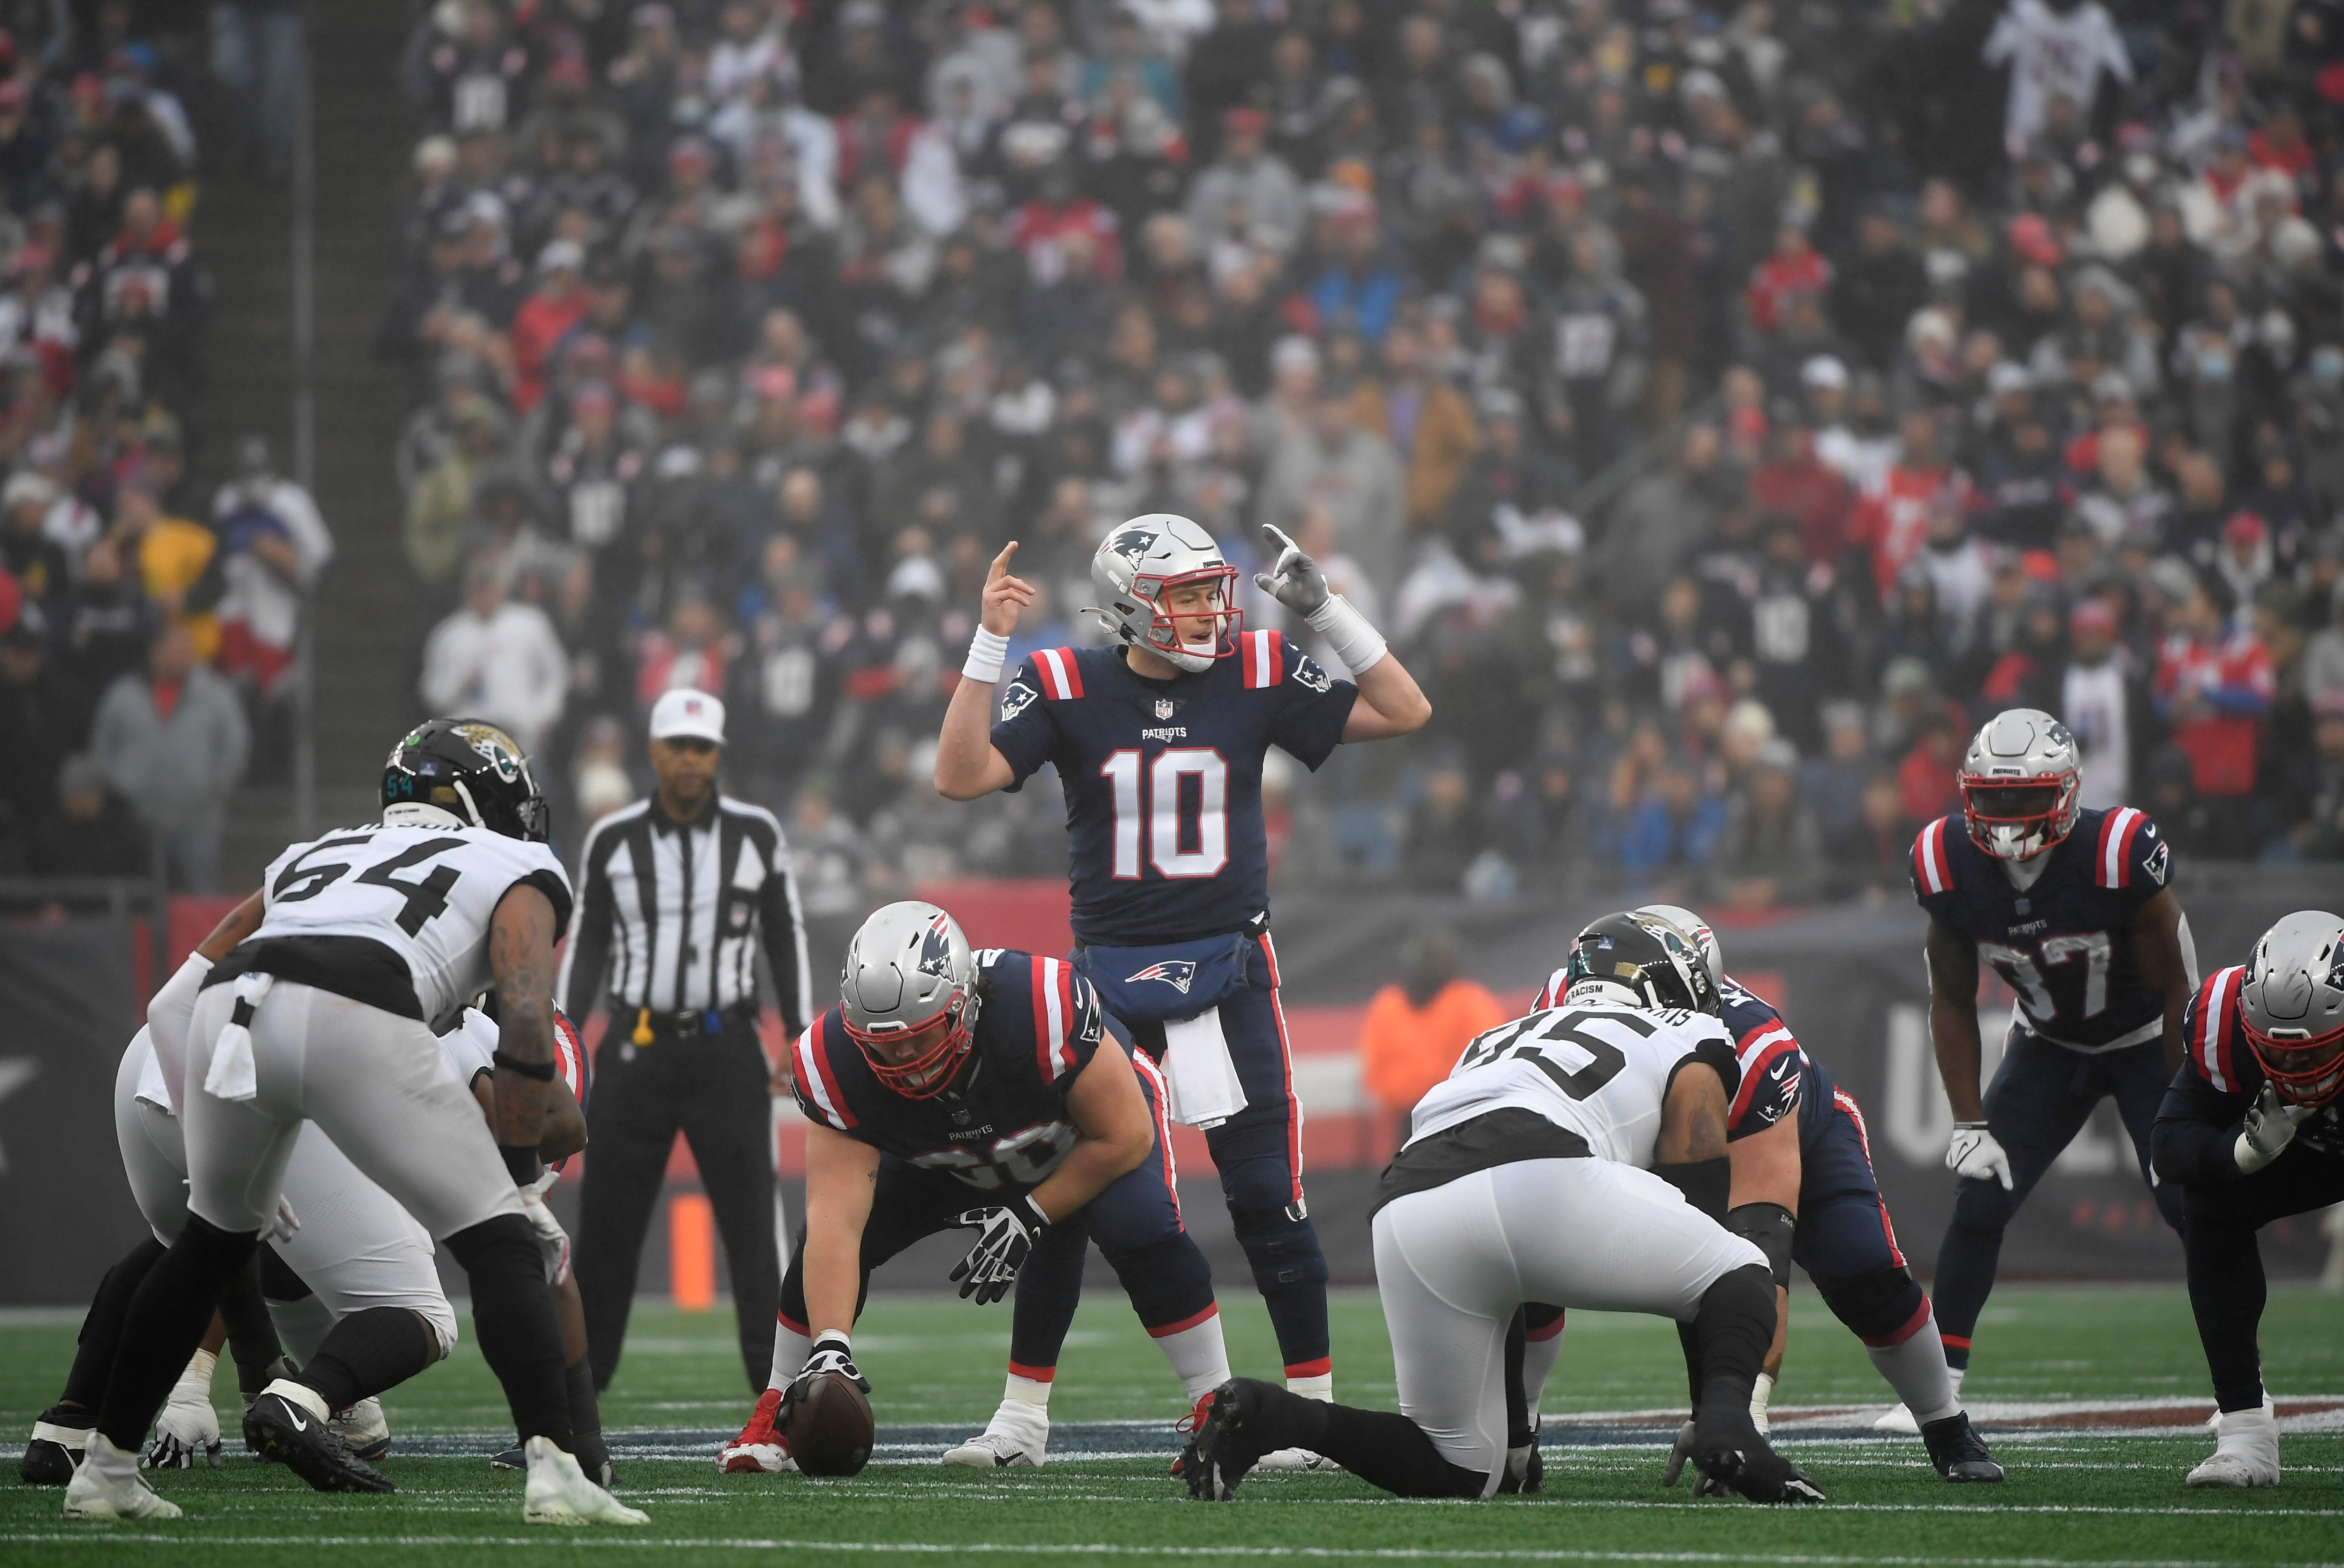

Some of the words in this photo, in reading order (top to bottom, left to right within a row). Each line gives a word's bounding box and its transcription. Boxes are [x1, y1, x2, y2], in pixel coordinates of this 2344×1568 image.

[1158, 708, 1170, 716] NFL
[1142, 727, 1187, 740] PATRIOTS
[387, 774, 413, 798] 54
[1100, 746, 1230, 880] 10
[273, 834, 470, 939] 54
[1571, 984, 1603, 1000] RACISM
[1461, 1010, 1658, 1103] 95
[949, 1125, 993, 1141] PATRIOTS
